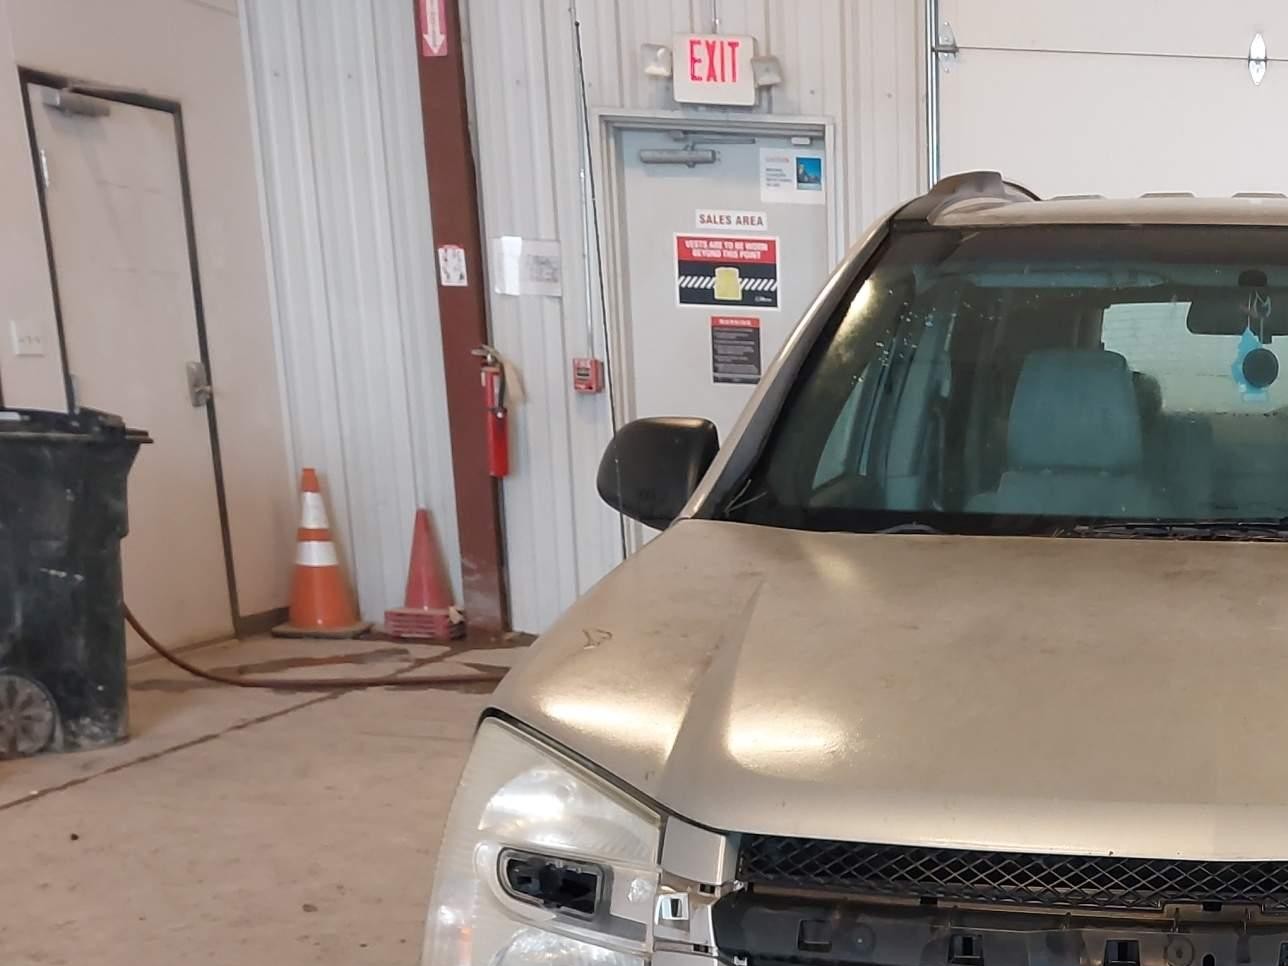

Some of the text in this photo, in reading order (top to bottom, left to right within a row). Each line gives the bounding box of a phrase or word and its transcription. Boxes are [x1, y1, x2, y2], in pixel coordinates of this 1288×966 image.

[690, 39, 740, 82] EXIT
[699, 214, 764, 226] SALES AREA
